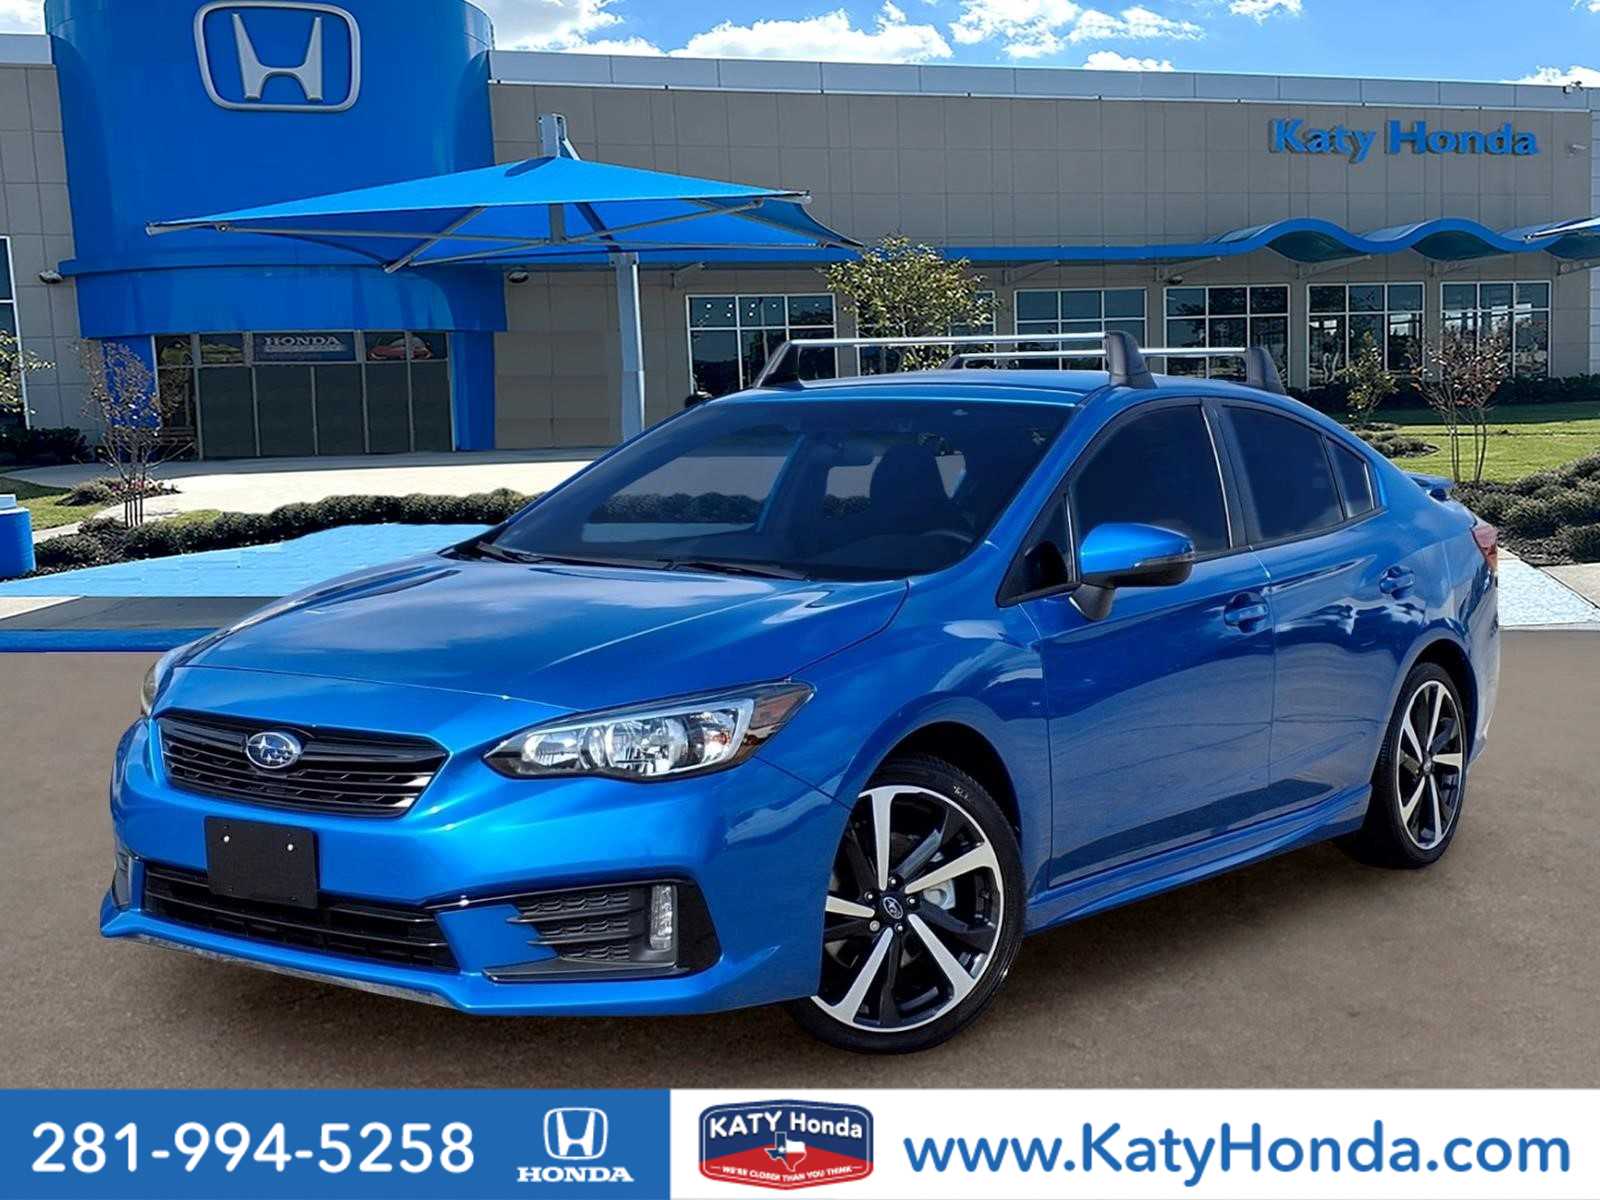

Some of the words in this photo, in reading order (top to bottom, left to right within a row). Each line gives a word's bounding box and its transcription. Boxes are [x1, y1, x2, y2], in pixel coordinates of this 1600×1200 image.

[1271, 118, 1376, 163] Katy
[1385, 120, 1538, 155] Honda
[264, 336, 342, 346] HONDA
